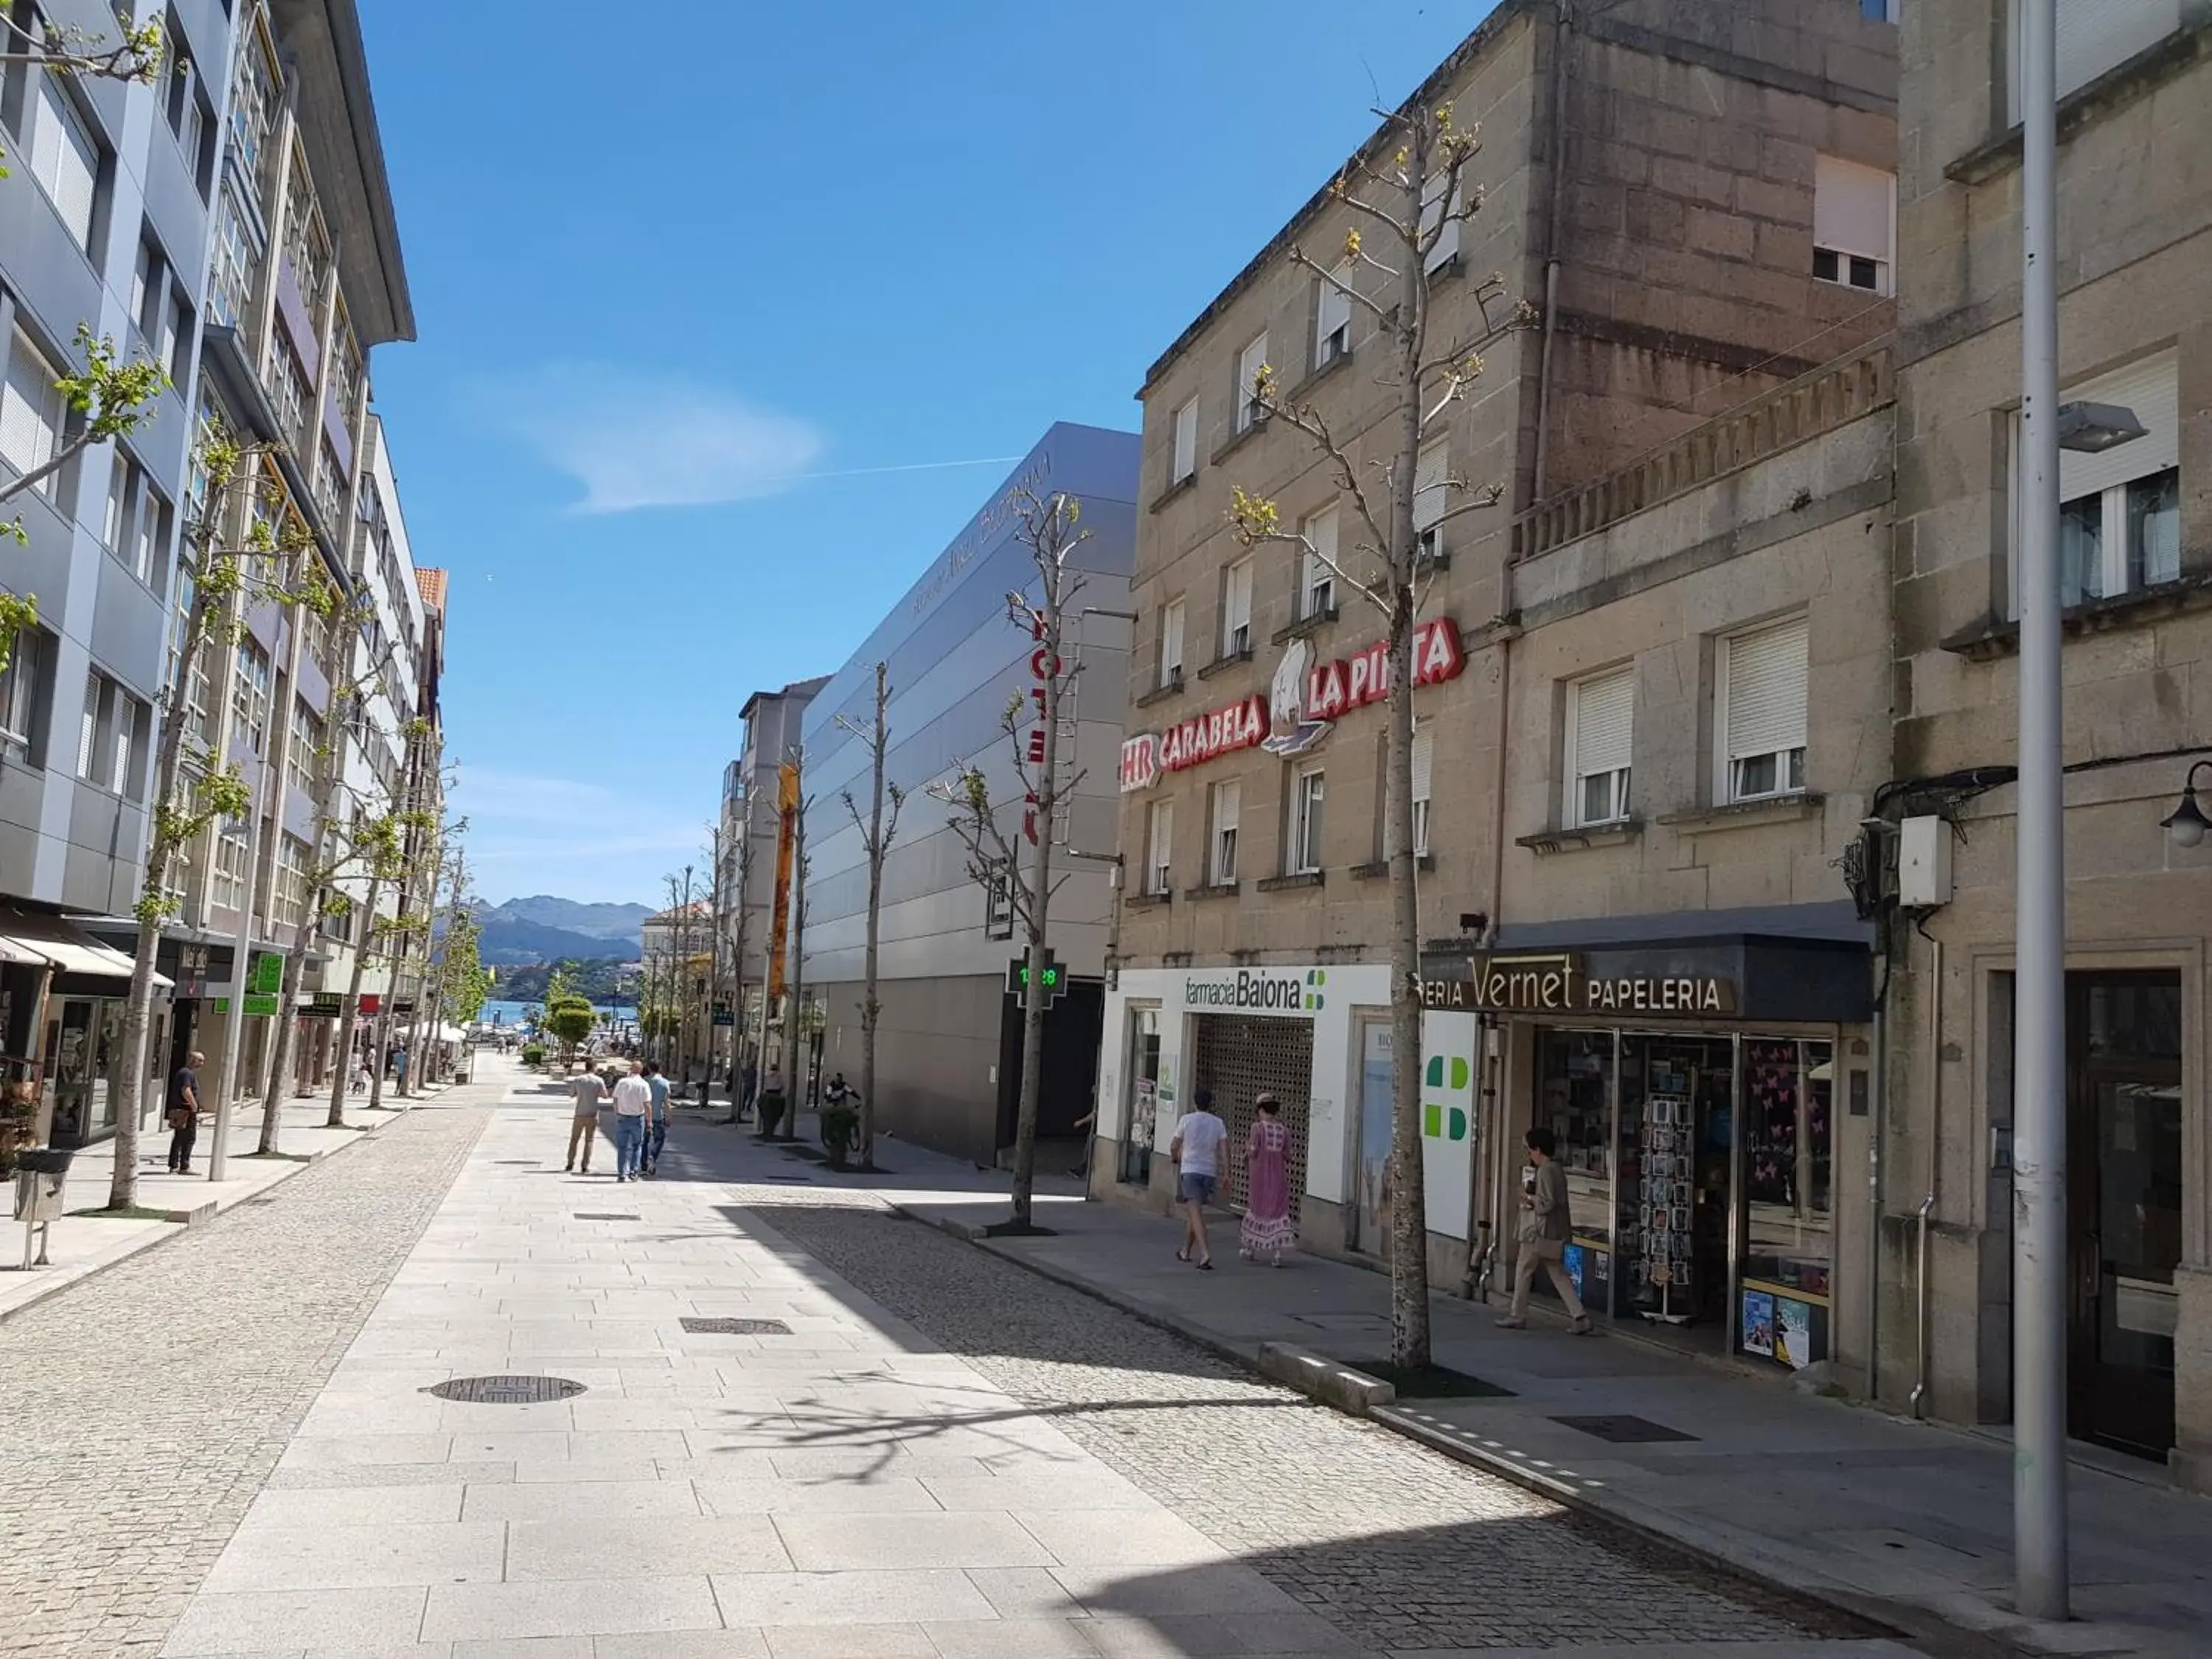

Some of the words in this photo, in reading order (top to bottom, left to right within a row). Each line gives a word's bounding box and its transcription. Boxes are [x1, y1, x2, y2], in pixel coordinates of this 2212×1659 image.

[1158, 695, 1262, 768] CARABELA
[1308, 667, 1343, 714] LA
[1185, 976, 1236, 1005] farmacia
[1236, 962, 1301, 1010] Baiona
[1467, 953, 1572, 1009] Vernet
[1588, 978, 1721, 1011] PAPELERIA
